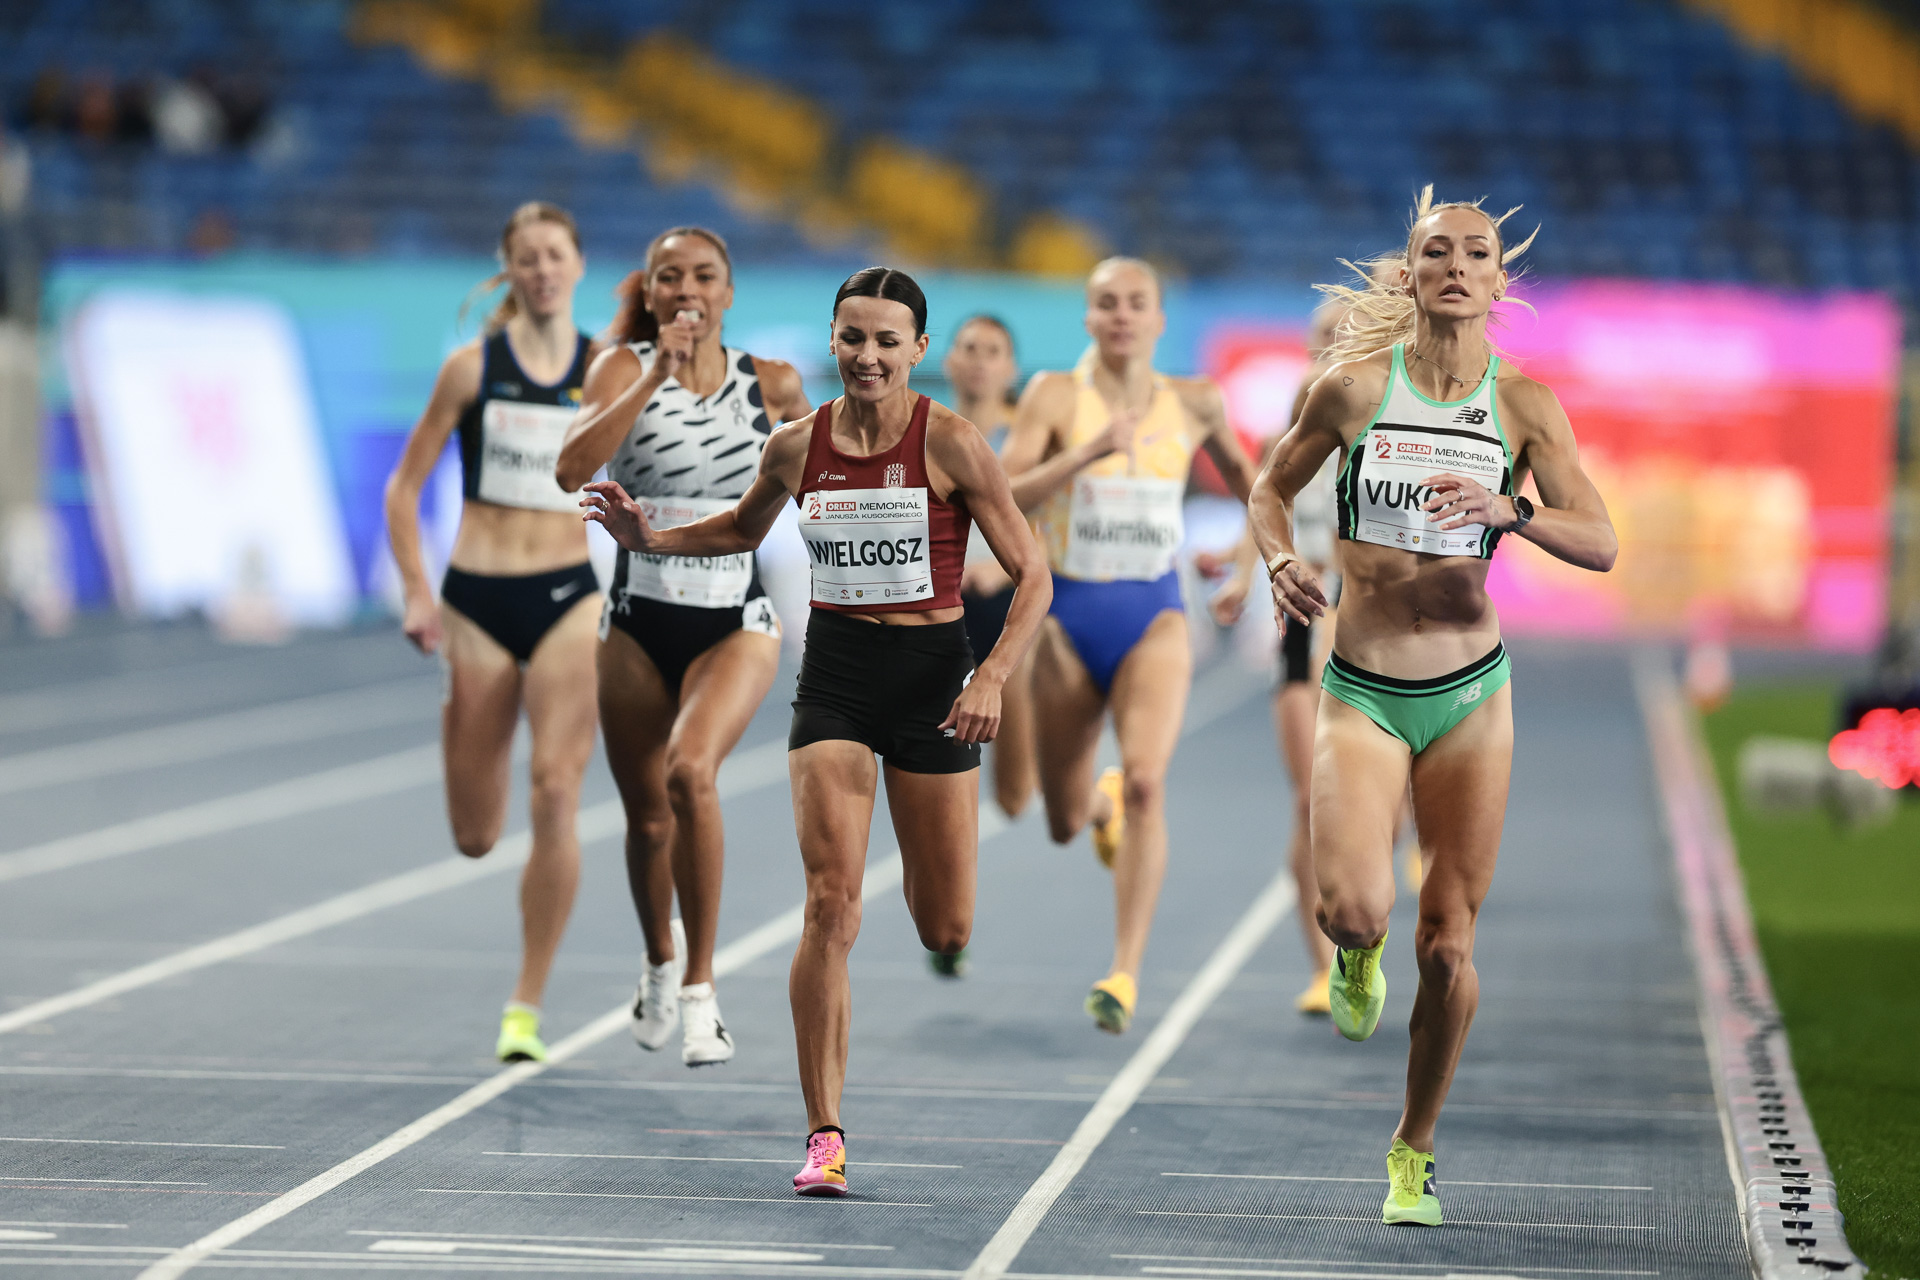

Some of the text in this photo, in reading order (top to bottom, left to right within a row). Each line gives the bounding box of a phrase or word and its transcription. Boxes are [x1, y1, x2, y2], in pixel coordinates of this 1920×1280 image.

[1395, 454, 1433, 464] JANUSZA
[1398, 444, 1498, 464] ORLEN MEMORIAŁ
[826, 501, 921, 511] ORLEN MEMORIAŁ
[861, 511, 923, 520] KUSOCIŃSKIEGO
[807, 537, 923, 568] WIELGOSZ
